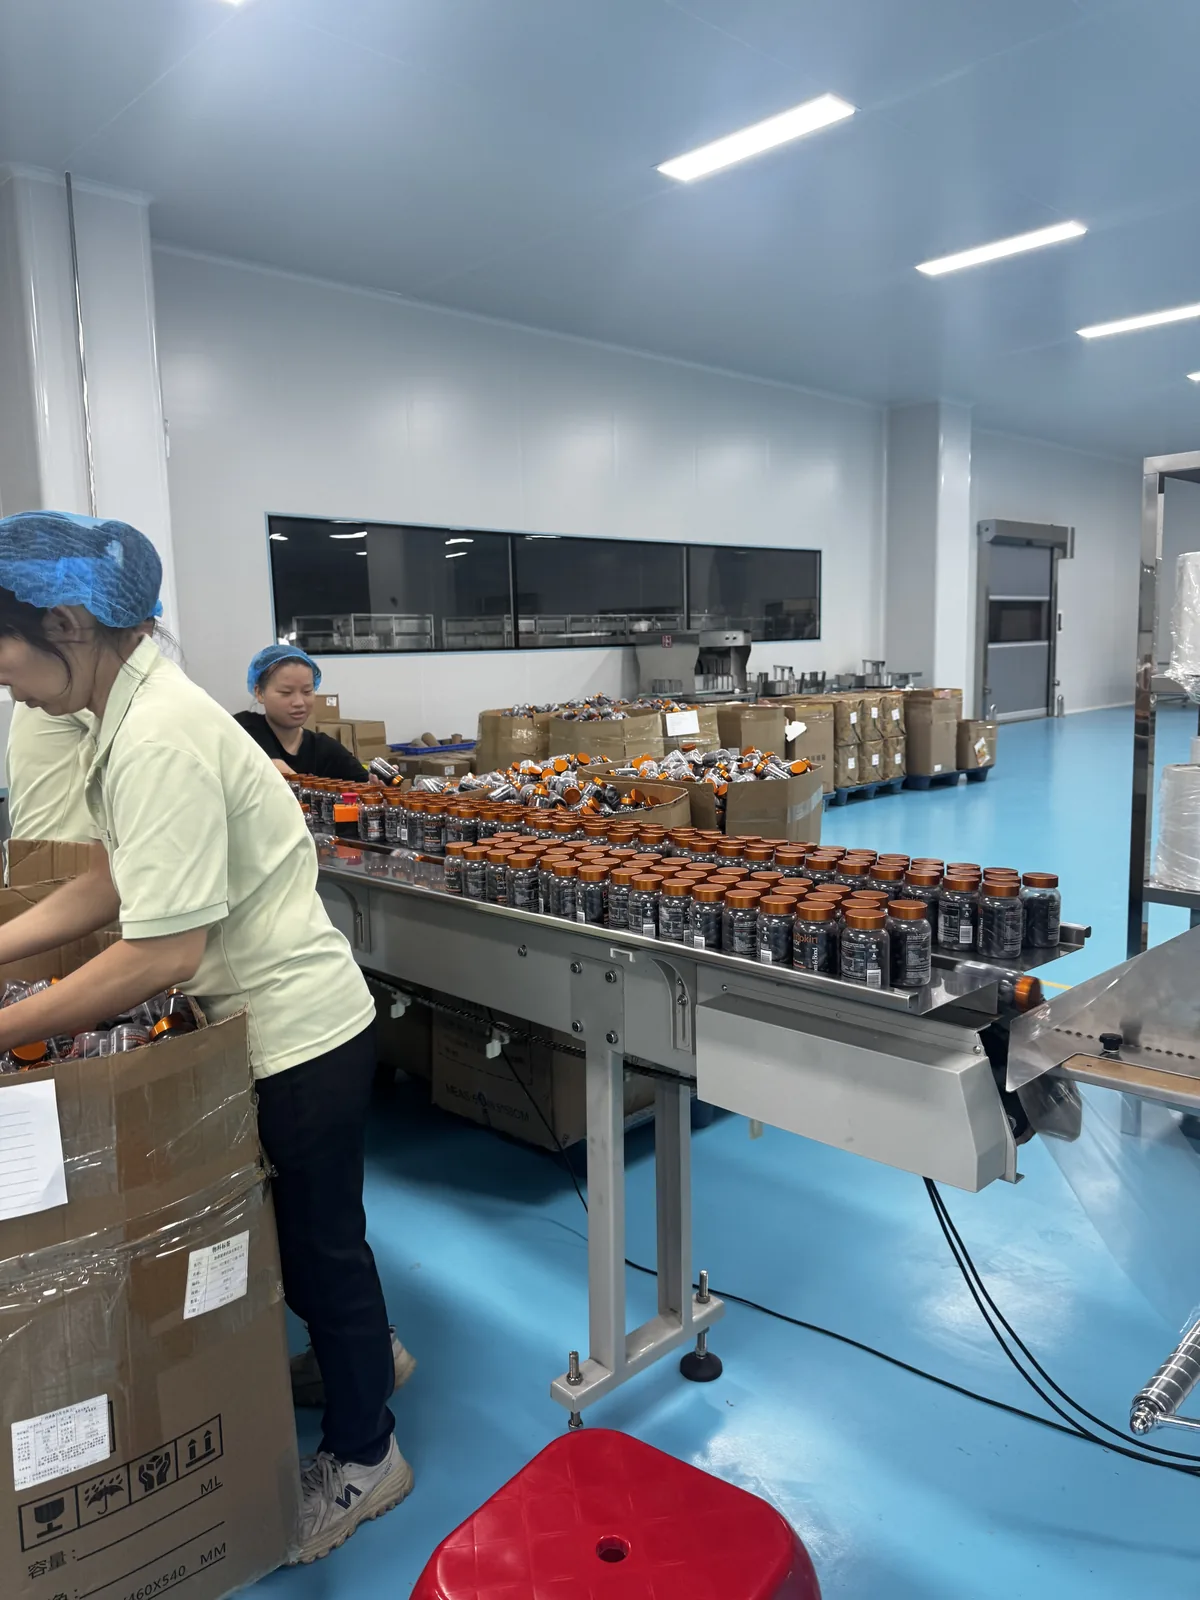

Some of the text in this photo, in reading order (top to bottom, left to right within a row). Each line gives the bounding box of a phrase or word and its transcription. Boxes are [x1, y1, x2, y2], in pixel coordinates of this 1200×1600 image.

[200, 1475, 222, 1495] ML
[123, 1542, 226, 1600] 460X540 MM
